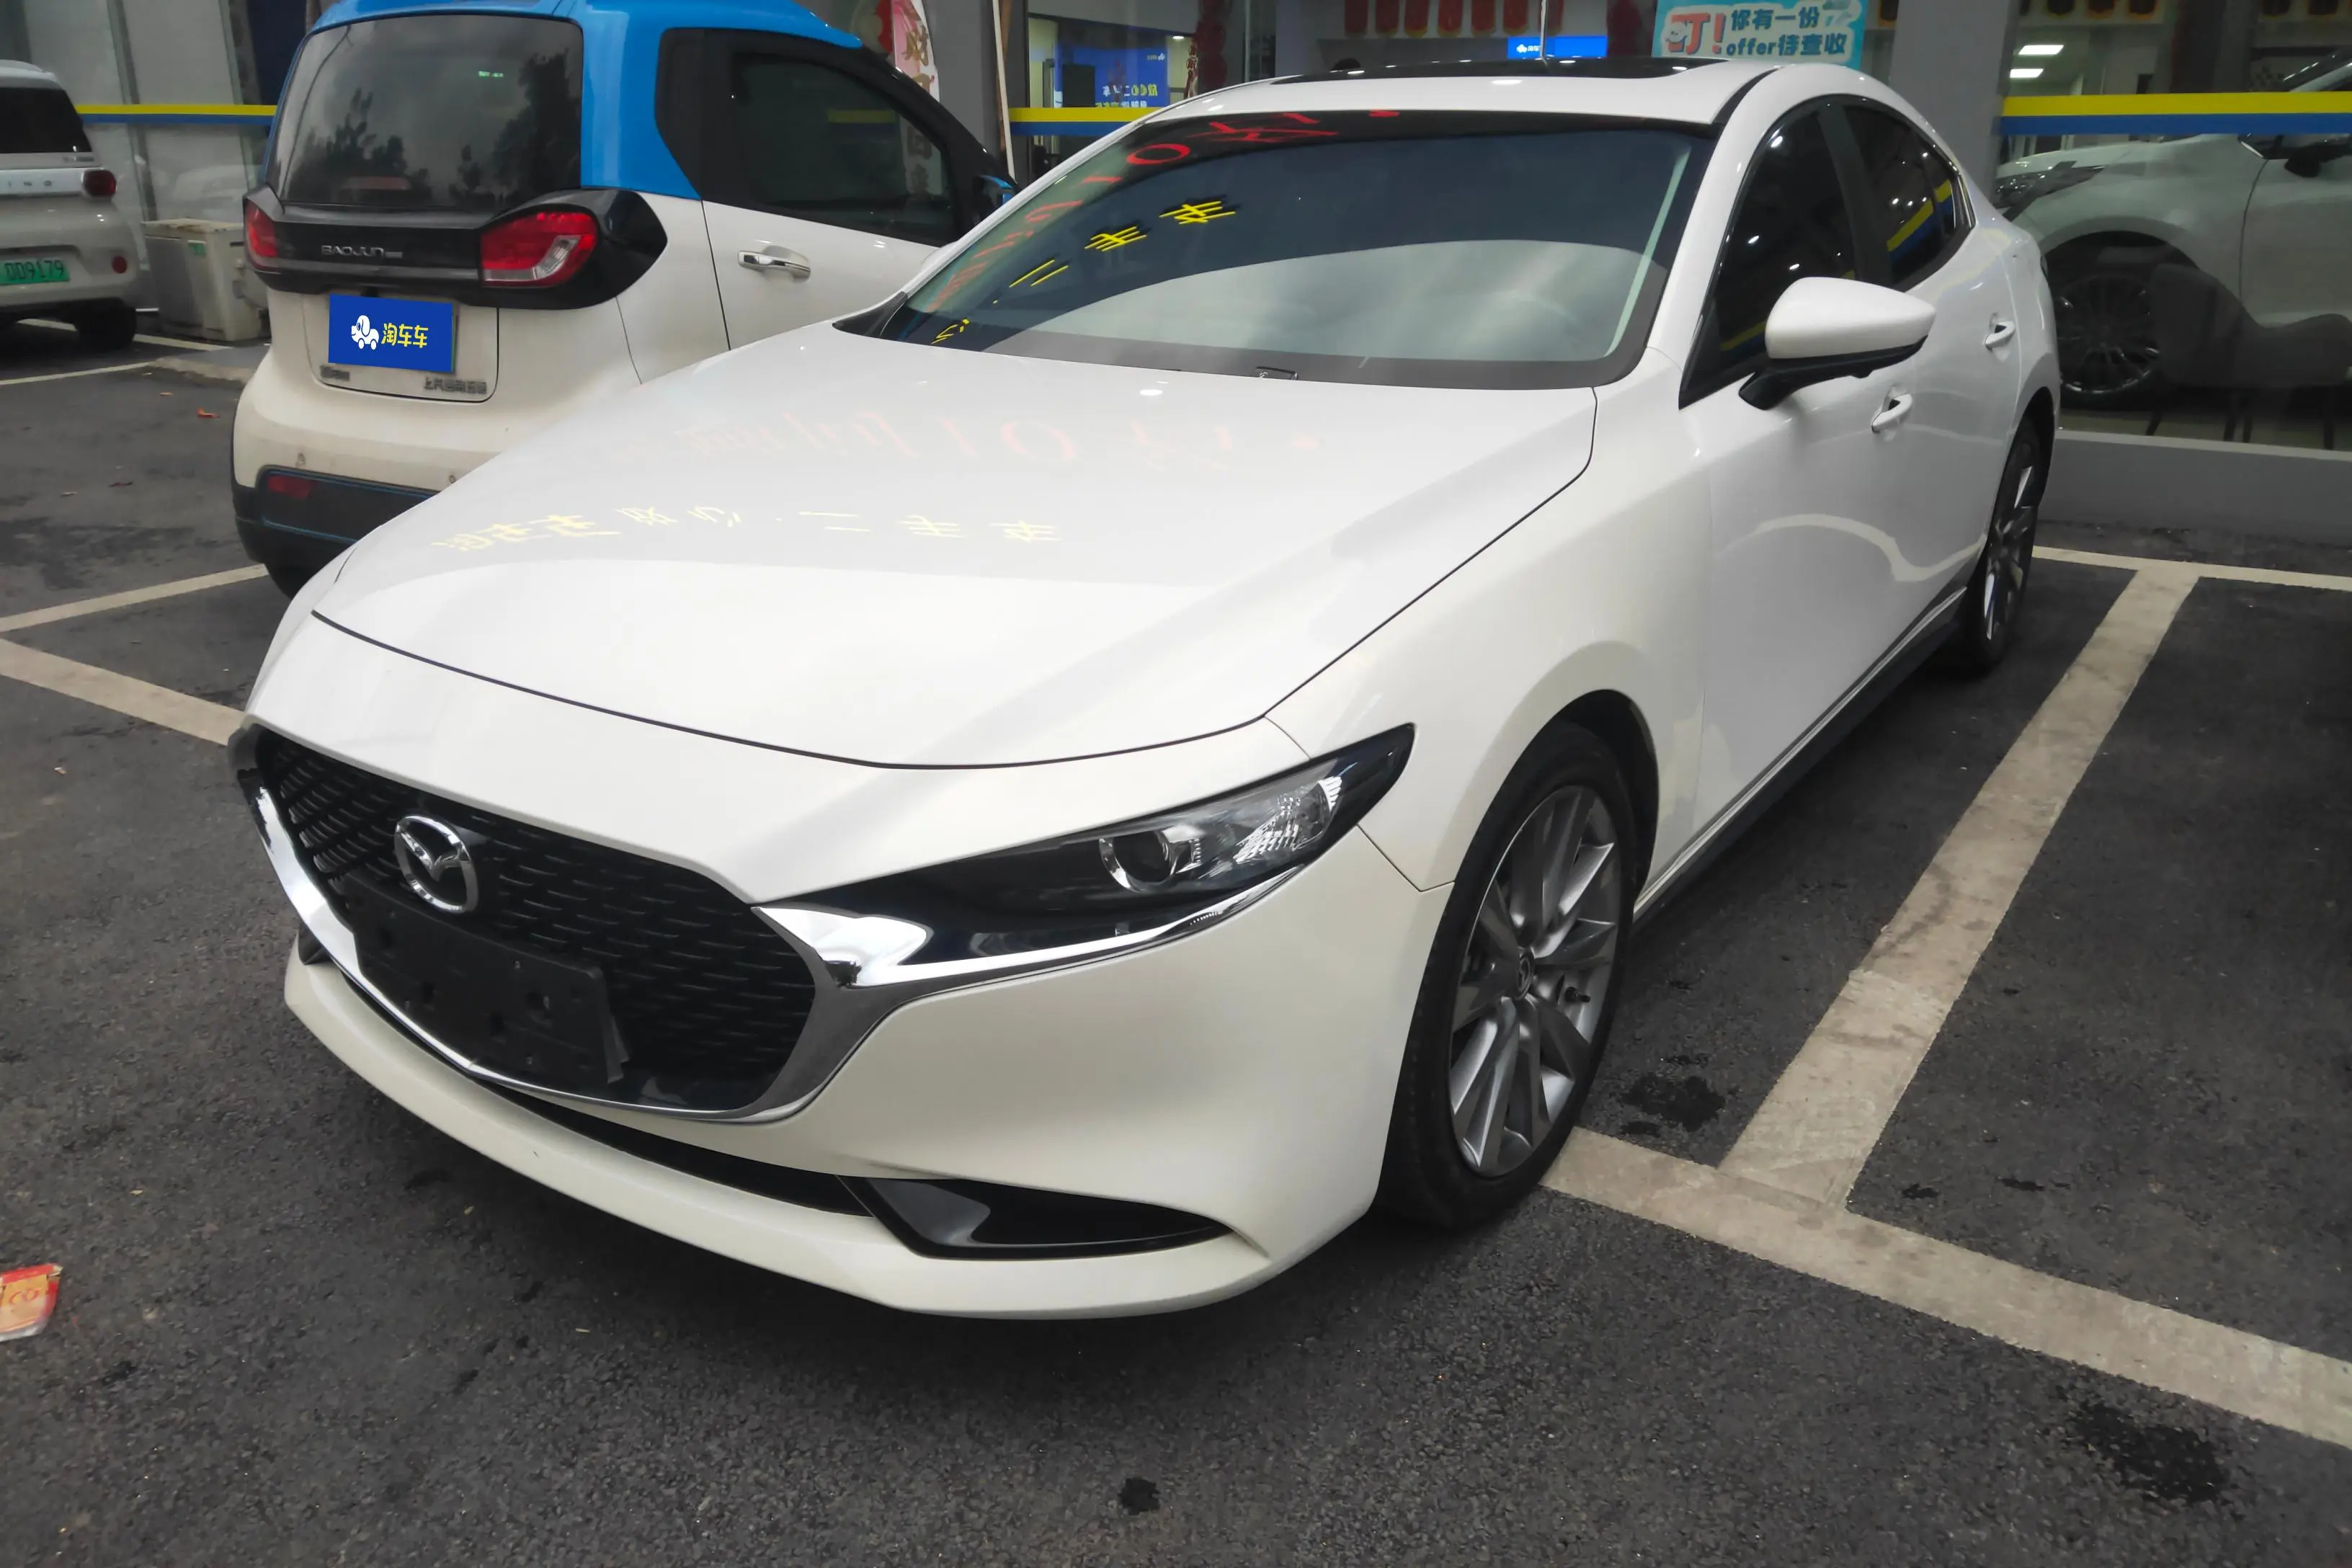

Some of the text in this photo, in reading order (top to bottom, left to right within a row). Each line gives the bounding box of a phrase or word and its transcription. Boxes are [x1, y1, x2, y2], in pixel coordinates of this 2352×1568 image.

[1731, 6, 1820, 31] 你有一份
[1726, 33, 1847, 56] offer待查收
[321, 245, 385, 257] BAOJUN
